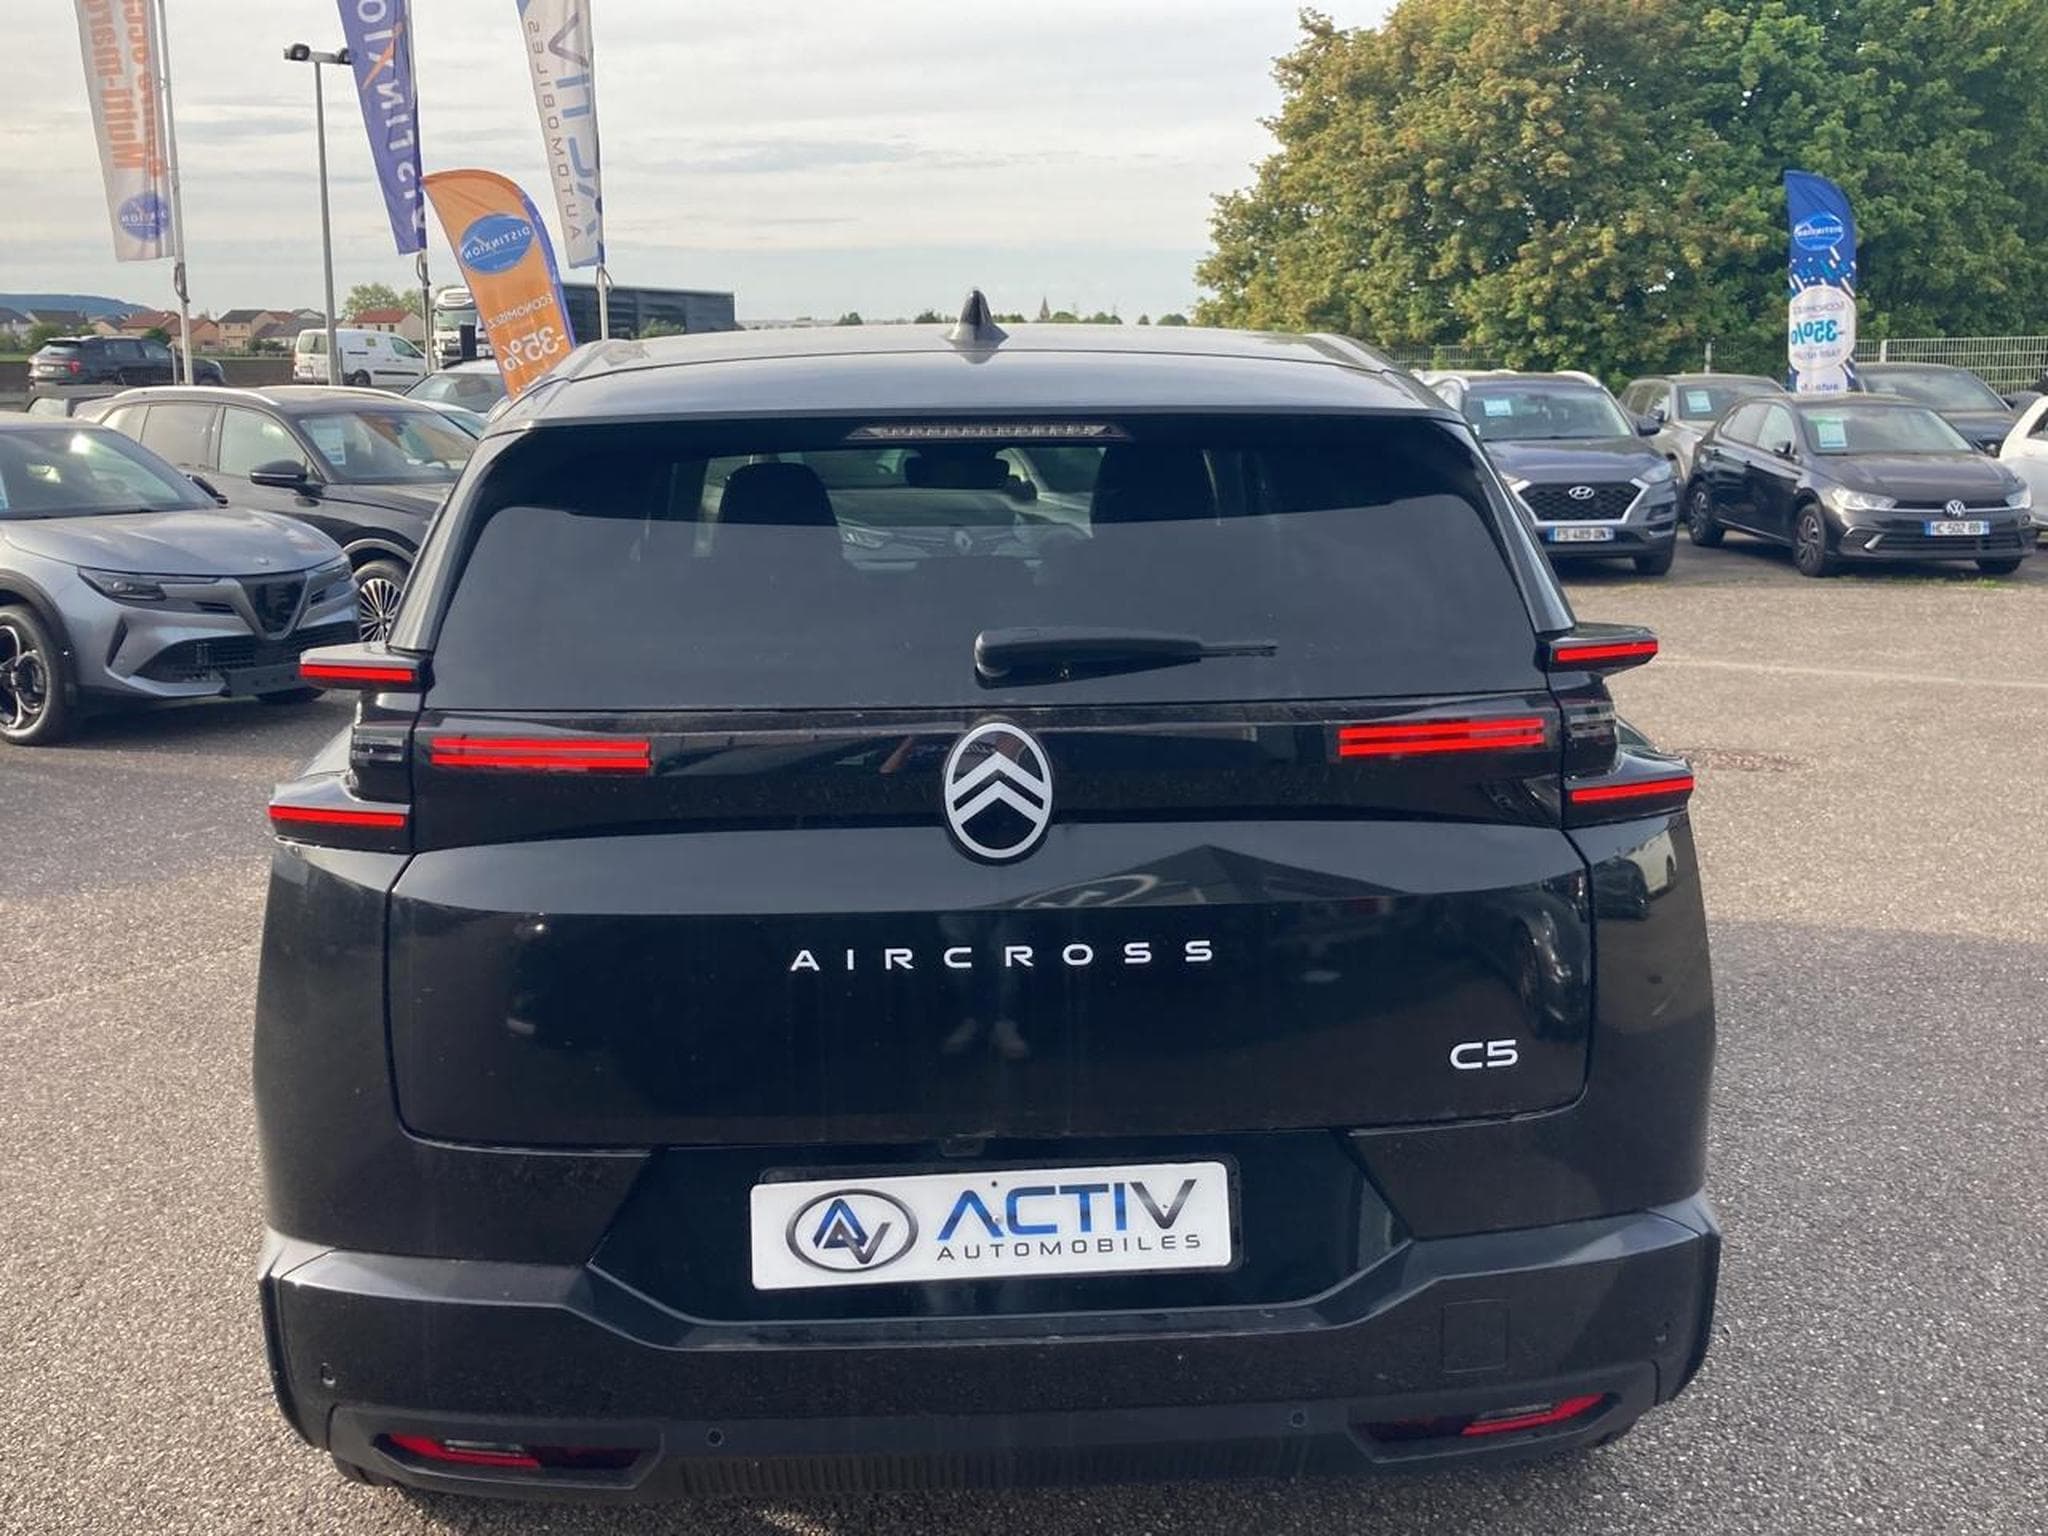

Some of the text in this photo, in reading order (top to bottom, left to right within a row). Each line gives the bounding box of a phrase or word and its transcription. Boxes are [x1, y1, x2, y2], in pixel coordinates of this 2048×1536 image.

[790, 940, 1214, 972] AIRCROSS
[1450, 1039, 1519, 1070] C5
[937, 1178, 1198, 1241] ACTIV
[937, 1233, 1201, 1262] AUTOMOBILES
